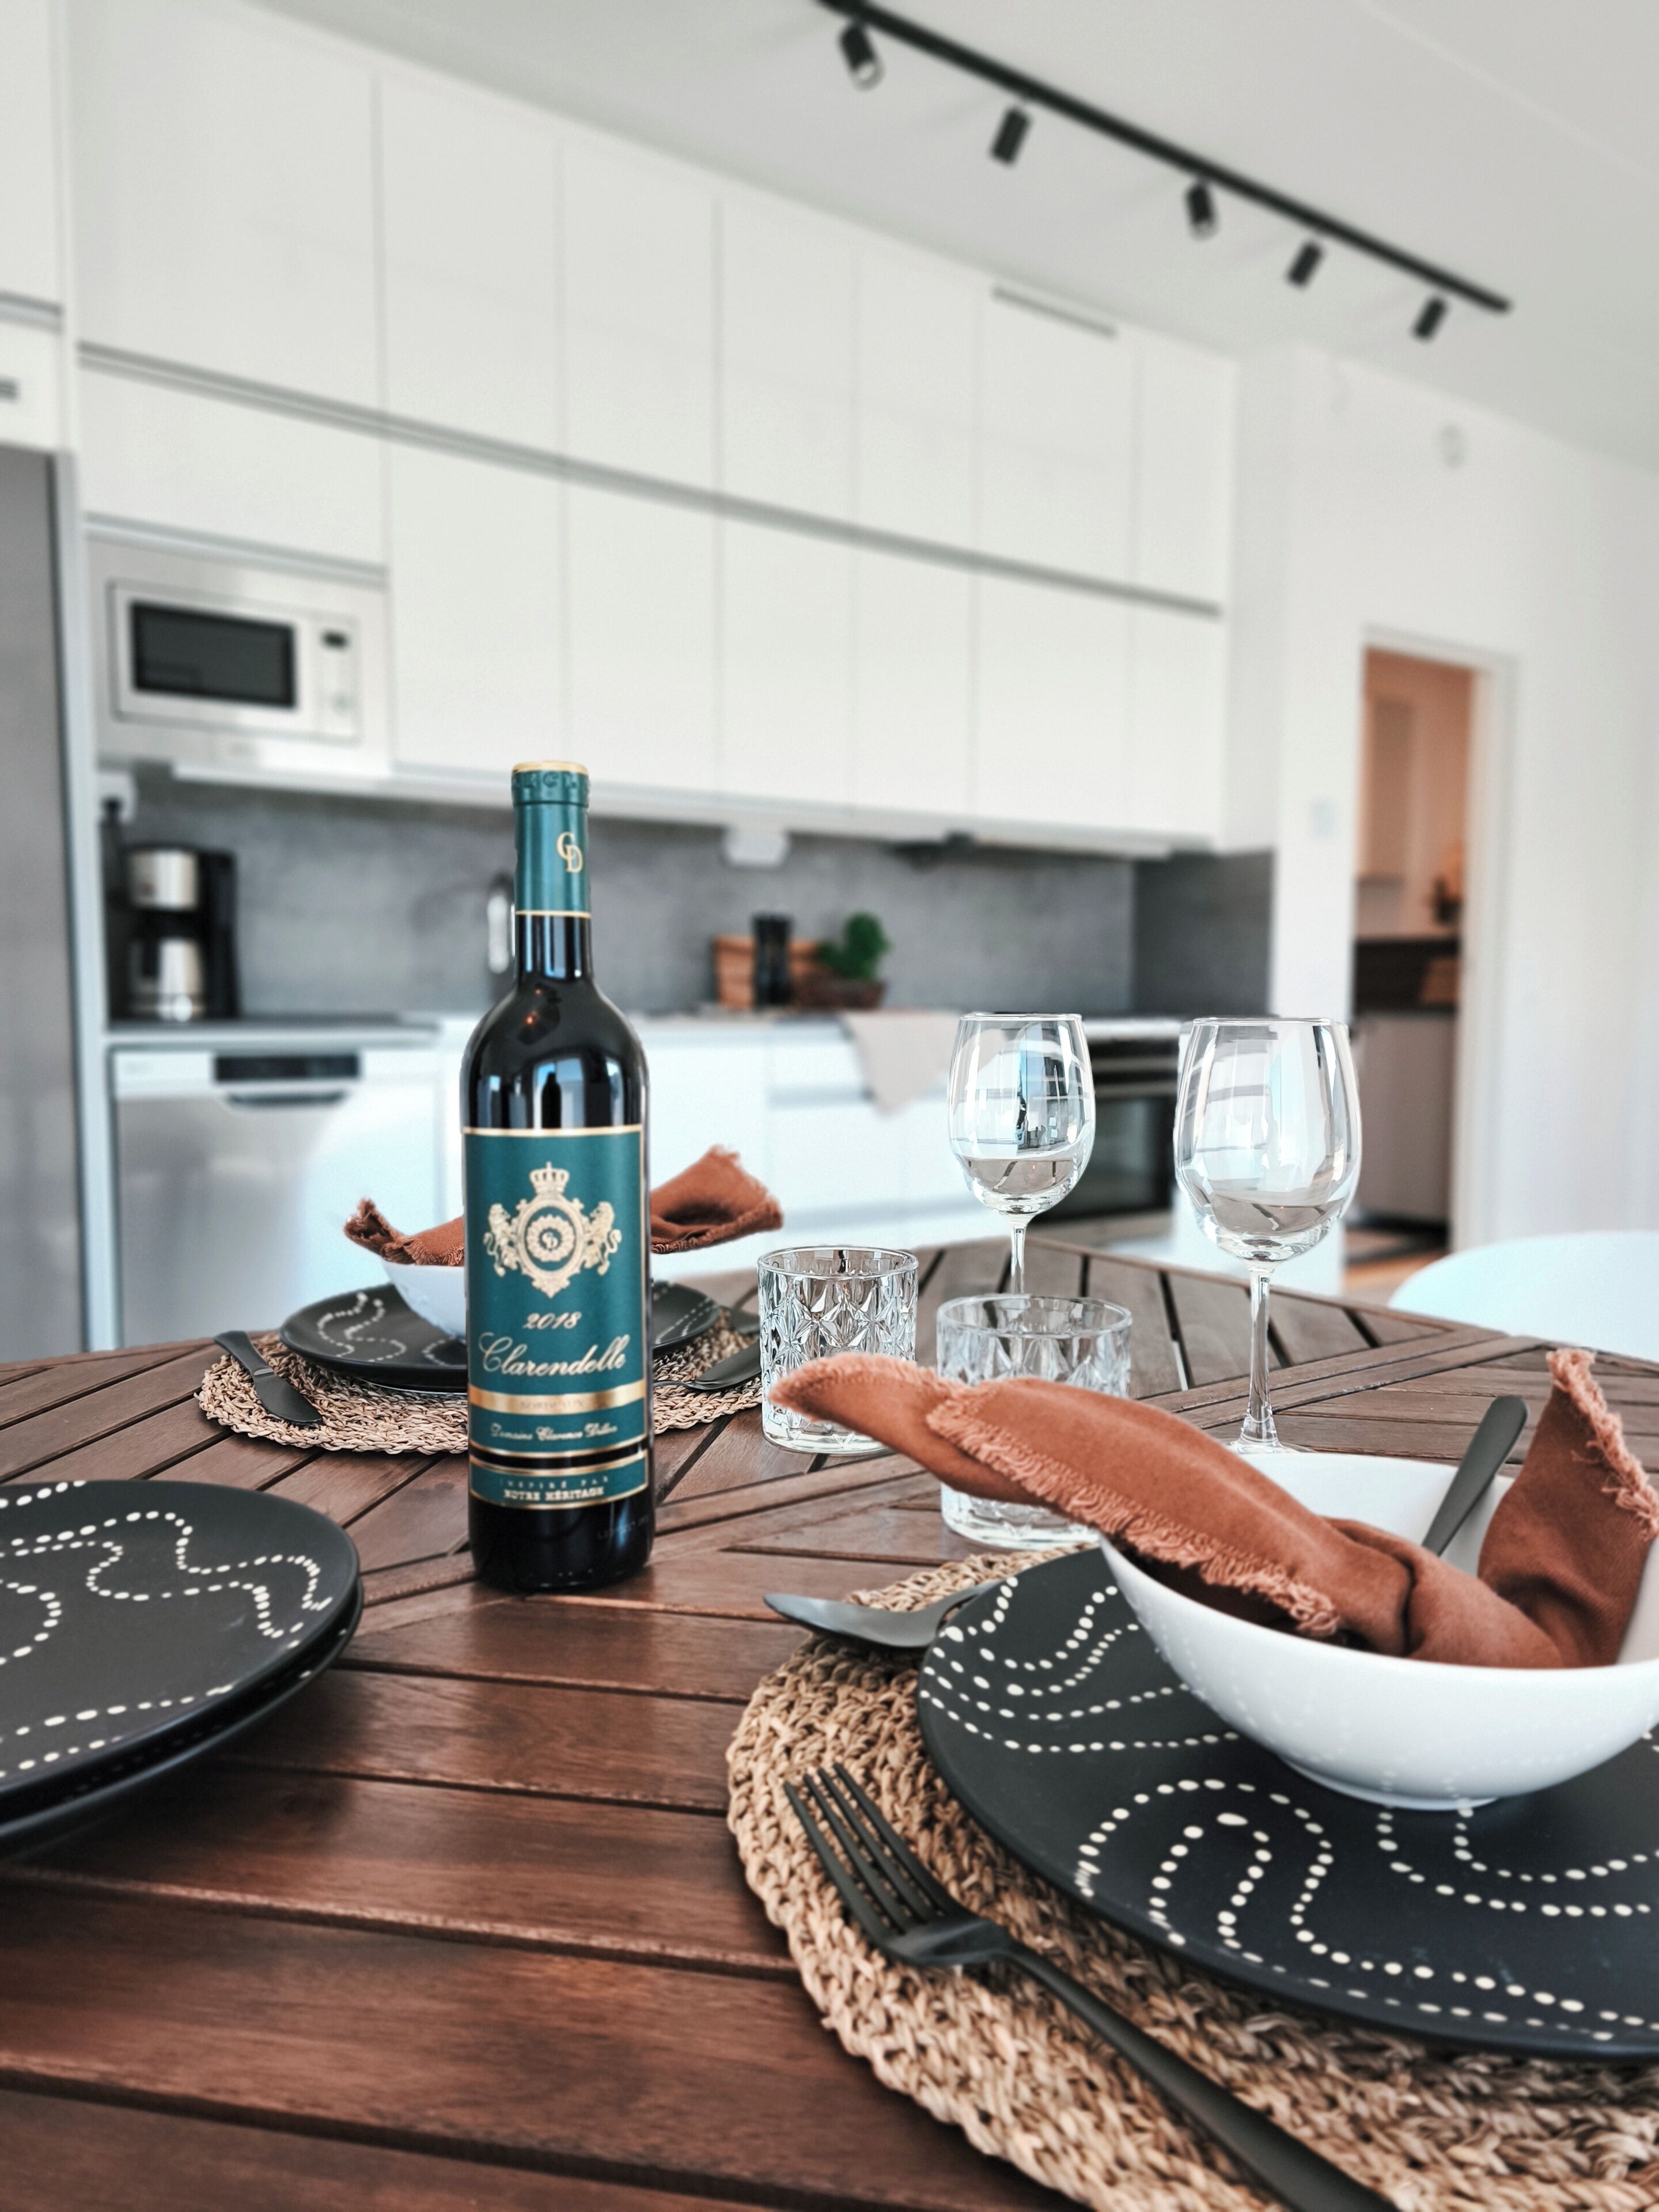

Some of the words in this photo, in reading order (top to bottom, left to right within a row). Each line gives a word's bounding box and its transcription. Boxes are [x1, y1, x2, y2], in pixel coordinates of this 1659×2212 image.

[522, 1312, 582, 1330] 2018
[479, 1332, 630, 1377] Clarendelle
[503, 1489, 541, 1501] NOTRE
[544, 1486, 605, 1501] HÉRITAGE
